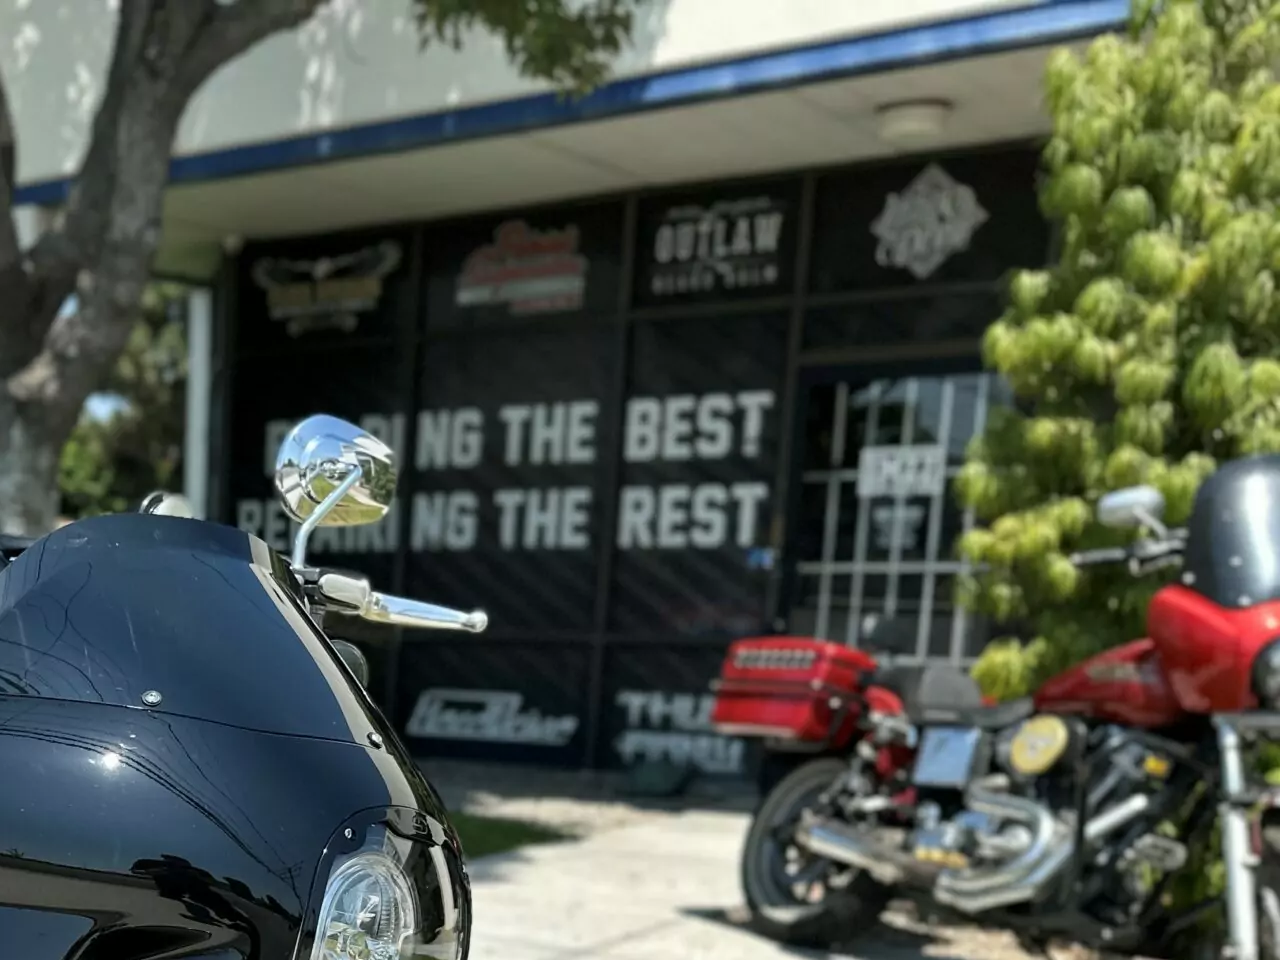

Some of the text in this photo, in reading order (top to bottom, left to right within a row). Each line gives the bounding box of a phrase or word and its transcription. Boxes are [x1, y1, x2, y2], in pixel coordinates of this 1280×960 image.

[654, 213, 783, 263] OUTLAW
[499, 399, 600, 466] THE
[623, 389, 775, 461] BEST
[493, 485, 594, 550] THE
[615, 482, 768, 550] REST
